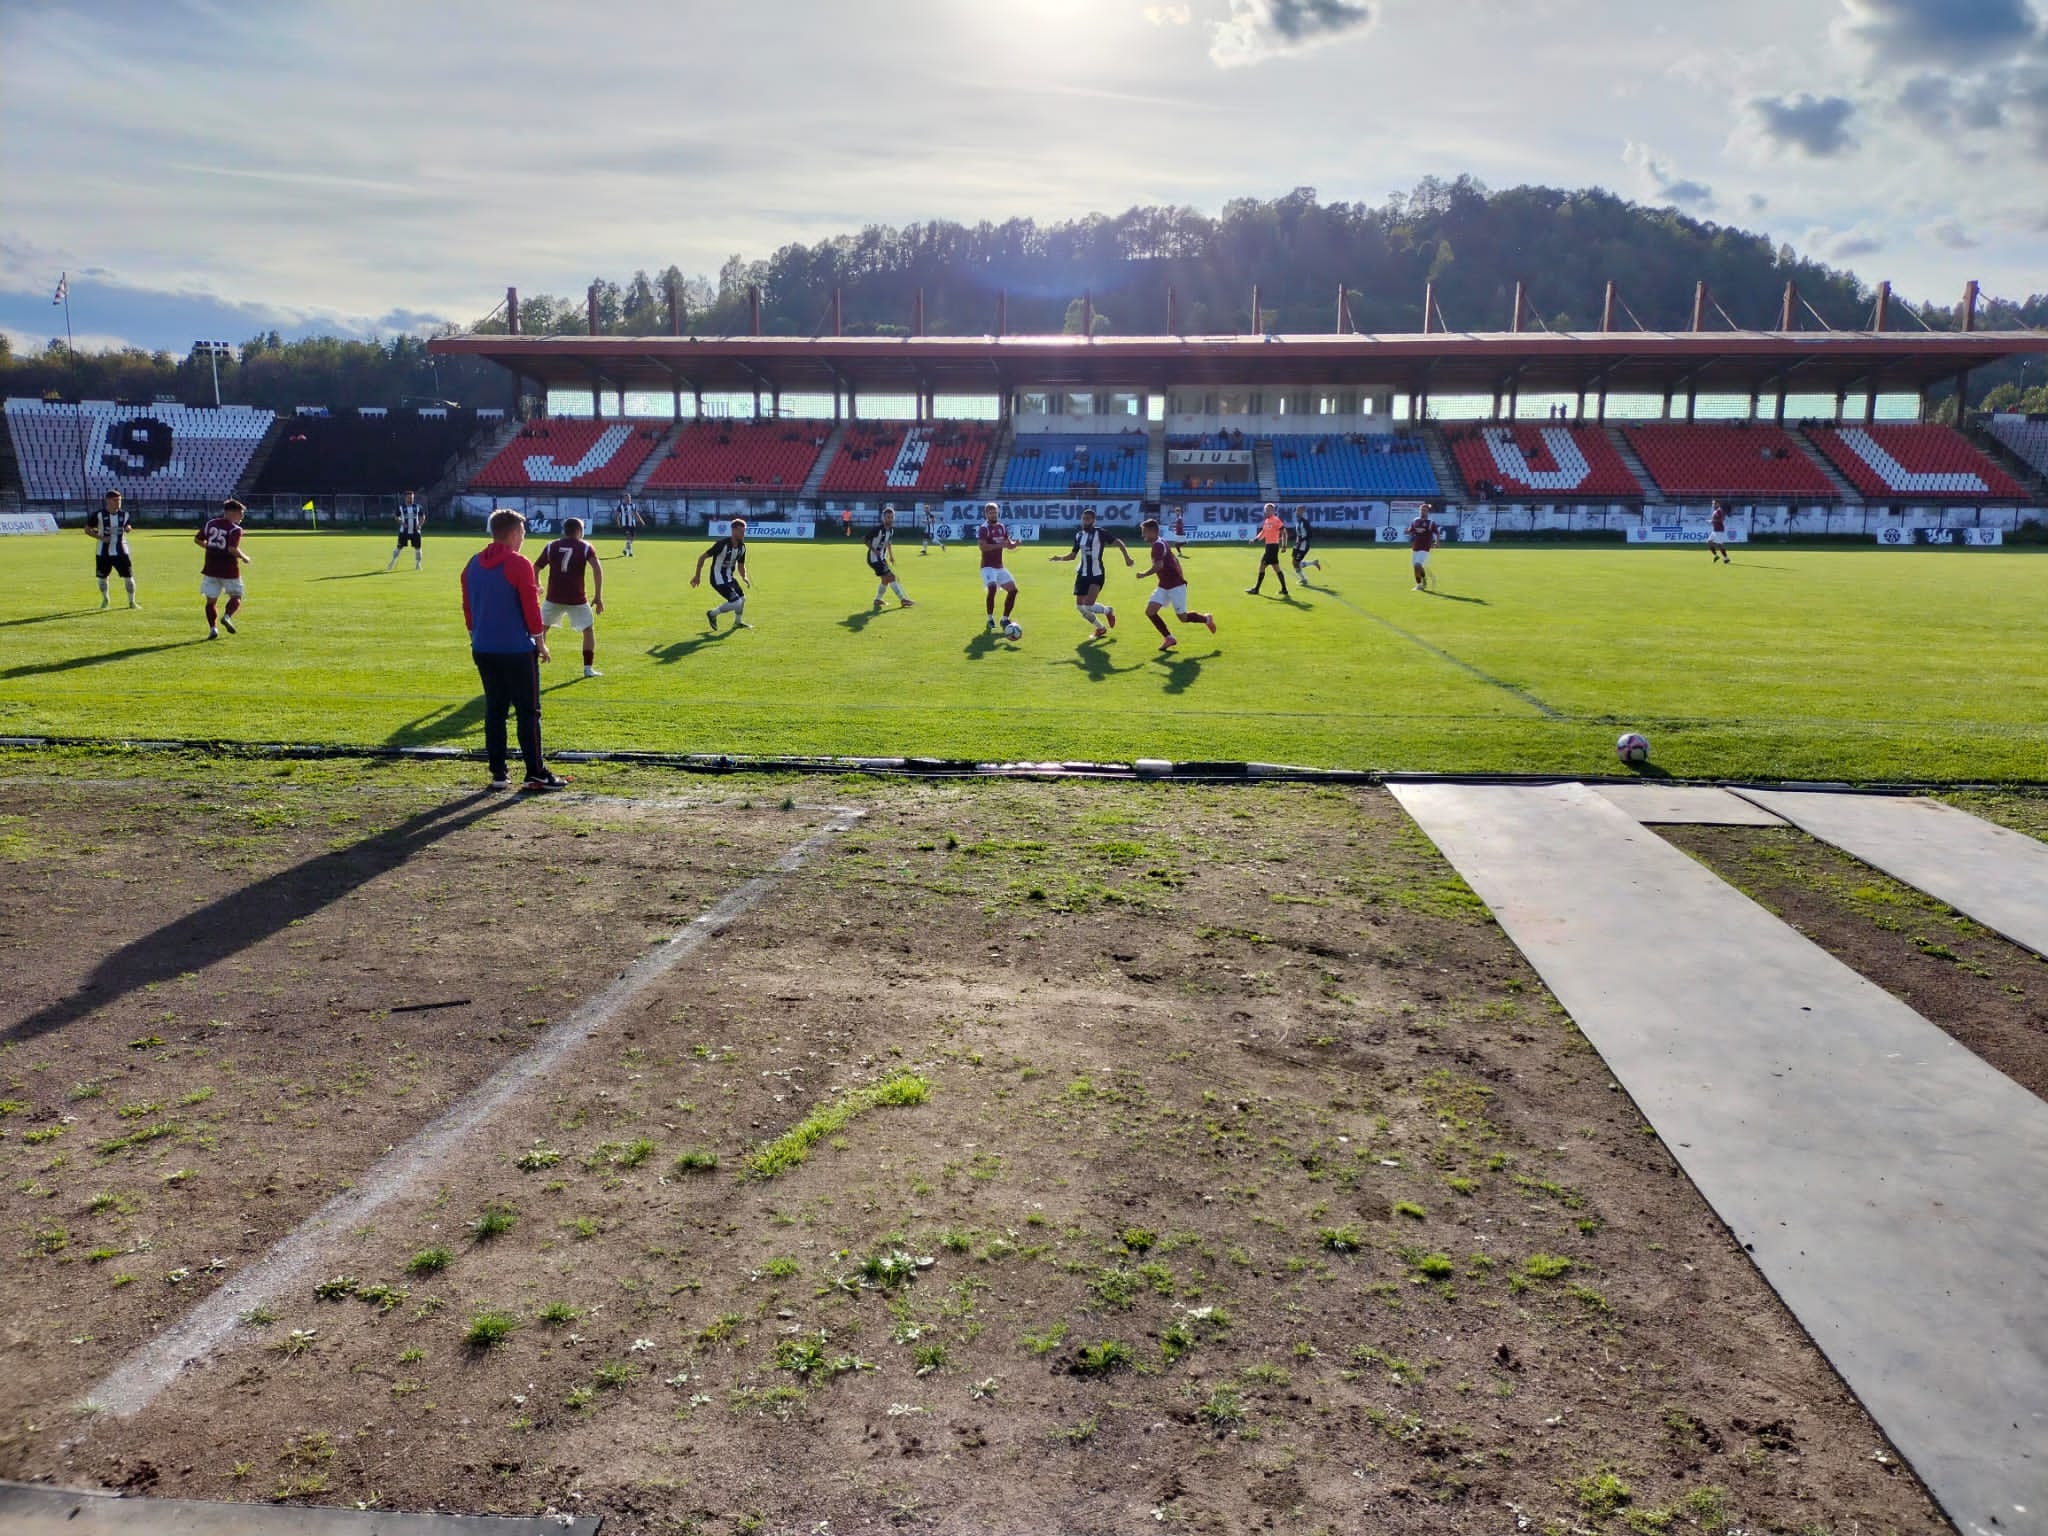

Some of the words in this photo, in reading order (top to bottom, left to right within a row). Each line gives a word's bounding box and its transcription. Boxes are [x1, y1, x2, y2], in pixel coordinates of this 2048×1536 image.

[1183, 452, 1237, 463] JIUL
[208, 526, 227, 549] 25
[559, 546, 574, 573] 7
